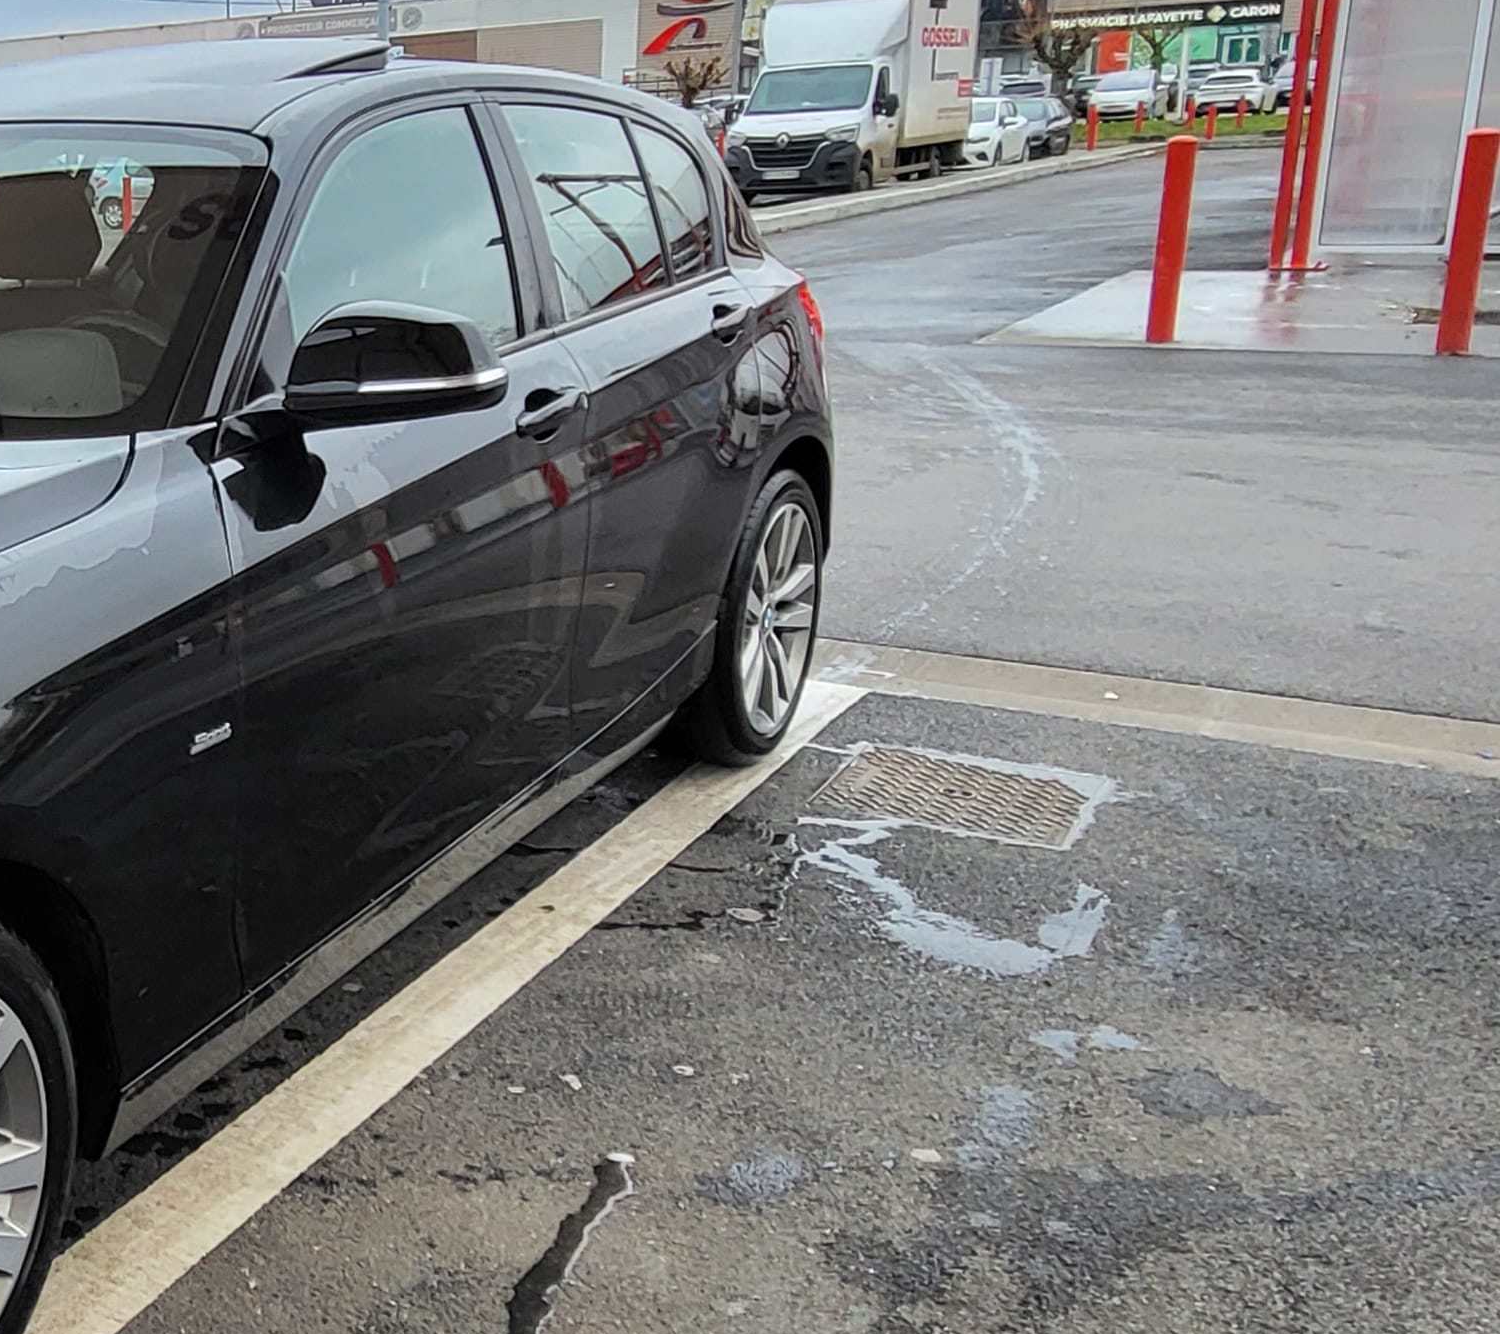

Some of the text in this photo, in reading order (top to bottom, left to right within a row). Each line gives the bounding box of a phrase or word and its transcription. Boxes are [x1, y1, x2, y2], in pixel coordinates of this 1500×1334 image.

[1129, 9, 1204, 27] LAFAYETTE
[1229, 3, 1281, 18] CARON
[921, 26, 970, 48] GOSSELIN
